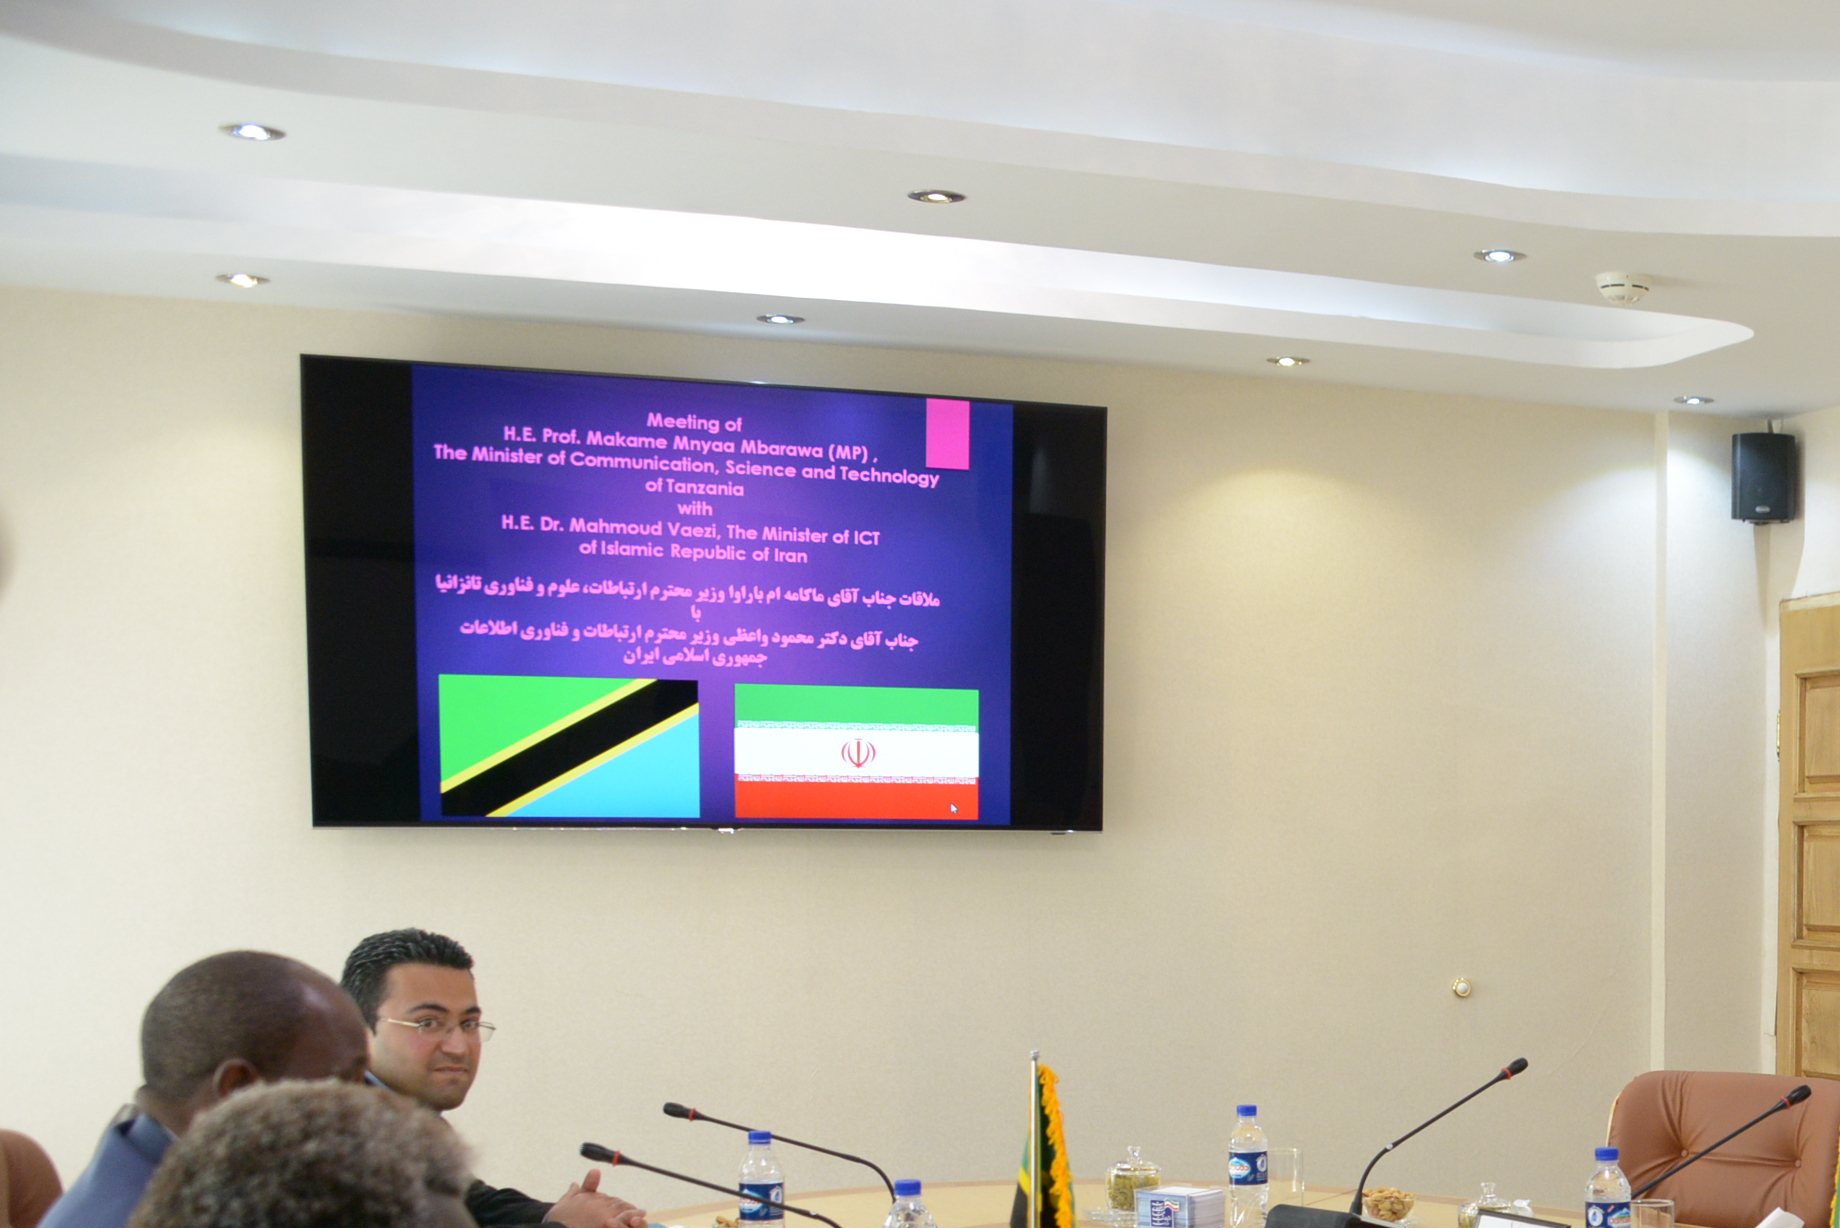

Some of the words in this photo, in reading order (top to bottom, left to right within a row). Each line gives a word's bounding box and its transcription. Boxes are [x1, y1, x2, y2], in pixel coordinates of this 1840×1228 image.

[646, 411, 721, 435] Meeting
[724, 416, 743, 433] of
[503, 425, 538, 443] H.E.
[542, 427, 582, 445] Prof.
[585, 429, 669, 450] Makame
[672, 434, 736, 456] Mnyaa
[740, 438, 824, 459] Mbarawa
[828, 443, 869, 465] (MP)
[433, 443, 469, 461] The
[471, 445, 544, 465] Minister
[546, 449, 567, 466] of
[569, 450, 720, 476] Communication,
[725, 459, 798, 478] Science
[801, 464, 837, 480] and
[839, 465, 941, 489] Technology
[644, 477, 664, 493] of
[665, 477, 745, 497] Tanzania
[677, 500, 714, 517] with
[501, 513, 536, 531] H.E.
[539, 515, 565, 532] Dr.
[568, 516, 663, 536] Mahmoud
[667, 521, 722, 541] Vaezi,
[726, 524, 759, 541] The
[761, 525, 829, 544] Minister
[831, 528, 851, 545] of
[853, 530, 881, 546] ICT
[578, 539, 598, 555] of
[600, 540, 665, 558] Islamic
[670, 543, 747, 562] Republic
[751, 546, 770, 562] of
[774, 547, 809, 564] Iran
[435, 573, 483, 595] تانزانیا
[483, 575, 535, 597] فناوری
[535, 583, 546, 598] و
[547, 578, 581, 598] علوم
[582, 579, 648, 601] ارتباطات،
[649, 584, 693, 602] محترم
[695, 586, 726, 604] وزیر
[728, 584, 765, 605] باراوا
[765, 586, 782, 605] ام
[783, 586, 825, 603] ماکامه
[826, 587, 861, 608] آقای
[861, 589, 898, 610] جناب
[898, 590, 941, 608] ملاقات
[690, 604, 702, 623] با
[459, 618, 519, 636] اطلاعات
[519, 621, 570, 642] فناوری
[571, 627, 581, 642] و
[582, 623, 643, 644] ارتباطات
[644, 627, 688, 645] محترم
[689, 629, 720, 646] وزیر
[722, 627, 769, 648] واعظی
[771, 631, 815, 648] محمود
[816, 630, 849, 650] دکتر
[849, 630, 884, 651] آقای
[884, 632, 920, 653] جناب
[623, 645, 661, 665] ایران
[662, 646, 711, 666] اسلامی
[712, 652, 769, 669] جمهوری
